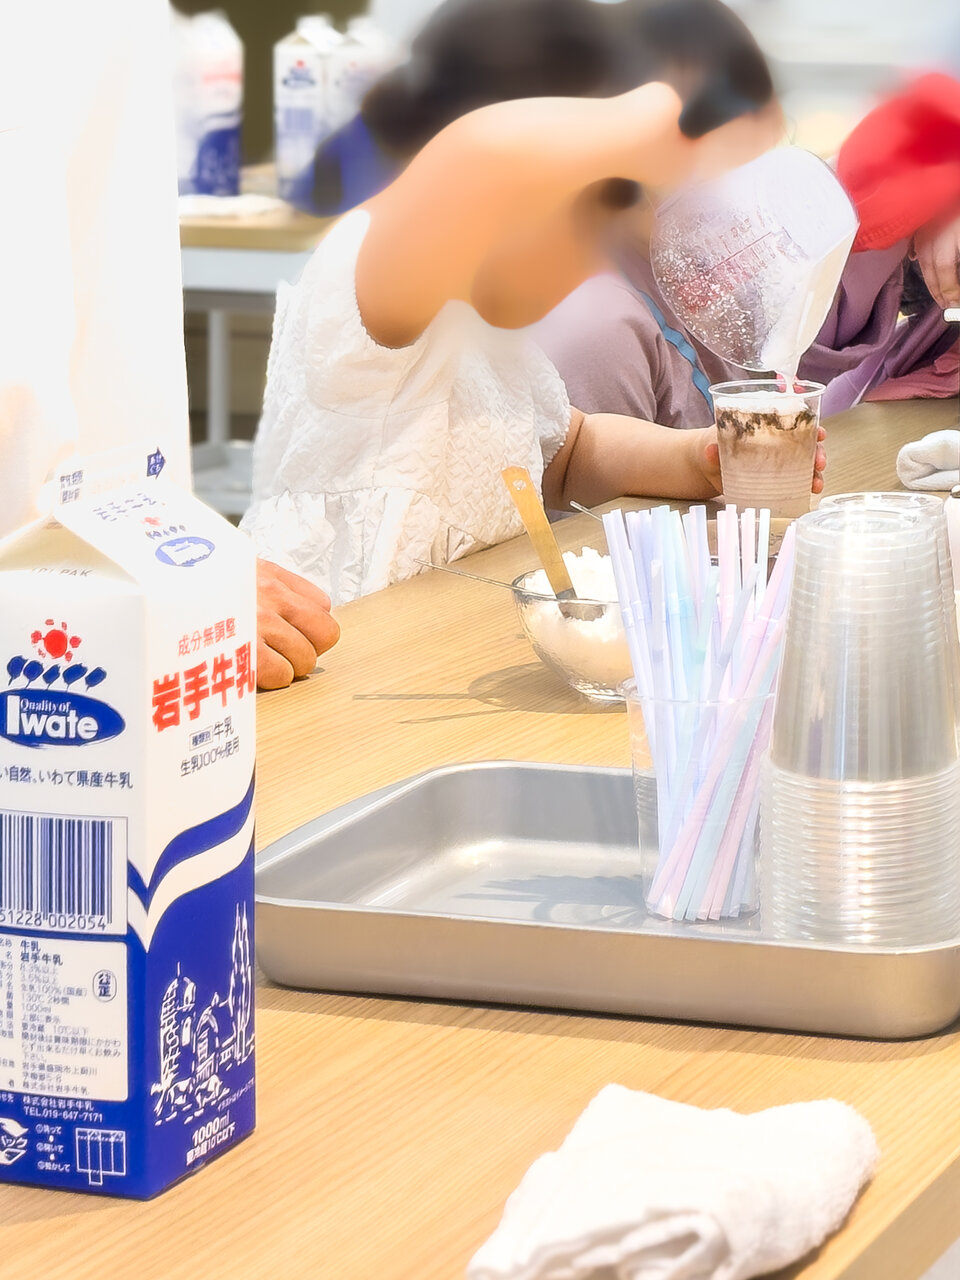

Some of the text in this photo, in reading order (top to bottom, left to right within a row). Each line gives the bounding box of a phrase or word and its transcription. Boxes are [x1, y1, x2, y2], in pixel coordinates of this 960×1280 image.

[178, 618, 236, 657] 成分無調整
[151, 641, 256, 733] 岩手牛乳
[6, 695, 98, 740] Iwate
[21, 699, 71, 714] Quality of
[213, 716, 235, 739] 牛乳
[48, 913, 106, 931] 002054
[20, 940, 41, 952] 牛乳
[20, 952, 63, 966] 岩手牛乳
[192, 1109, 229, 1147] 1000ml
